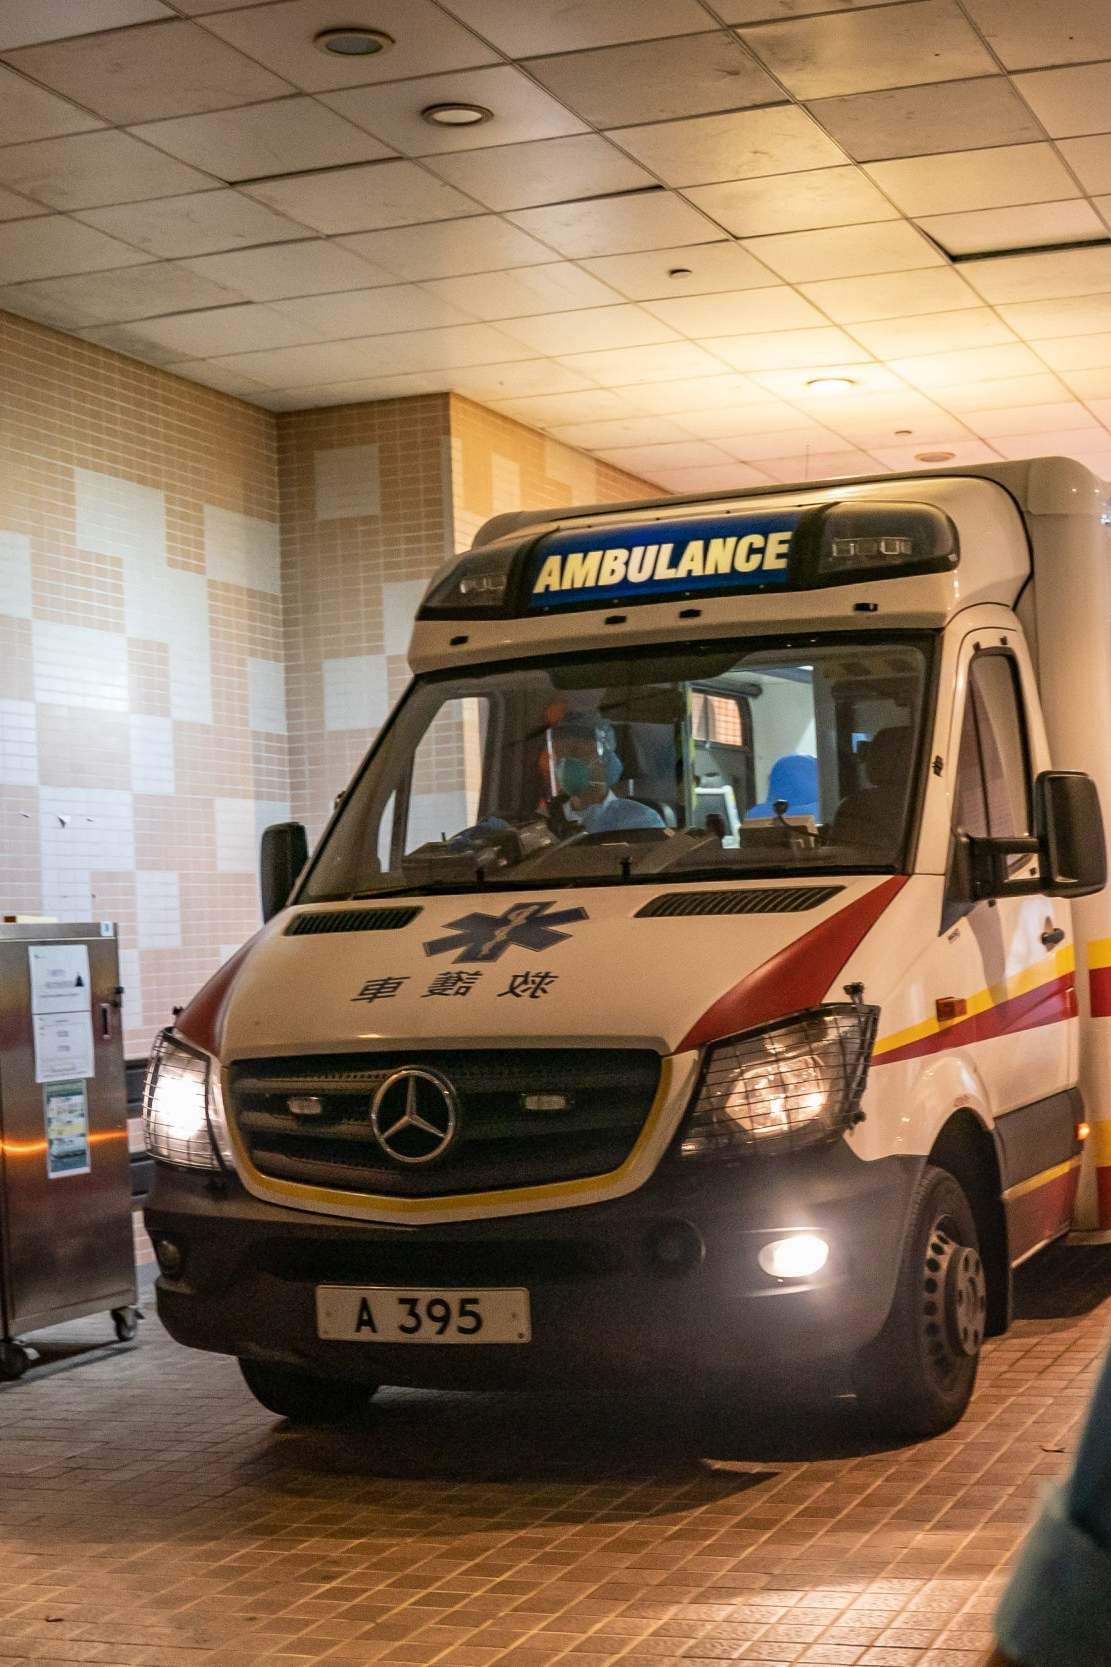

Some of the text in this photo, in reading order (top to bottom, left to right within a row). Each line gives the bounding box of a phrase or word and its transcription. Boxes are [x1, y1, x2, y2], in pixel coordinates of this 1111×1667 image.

[532, 531, 793, 594] AMBULANCE
[354, 1296, 483, 1335] A 395
